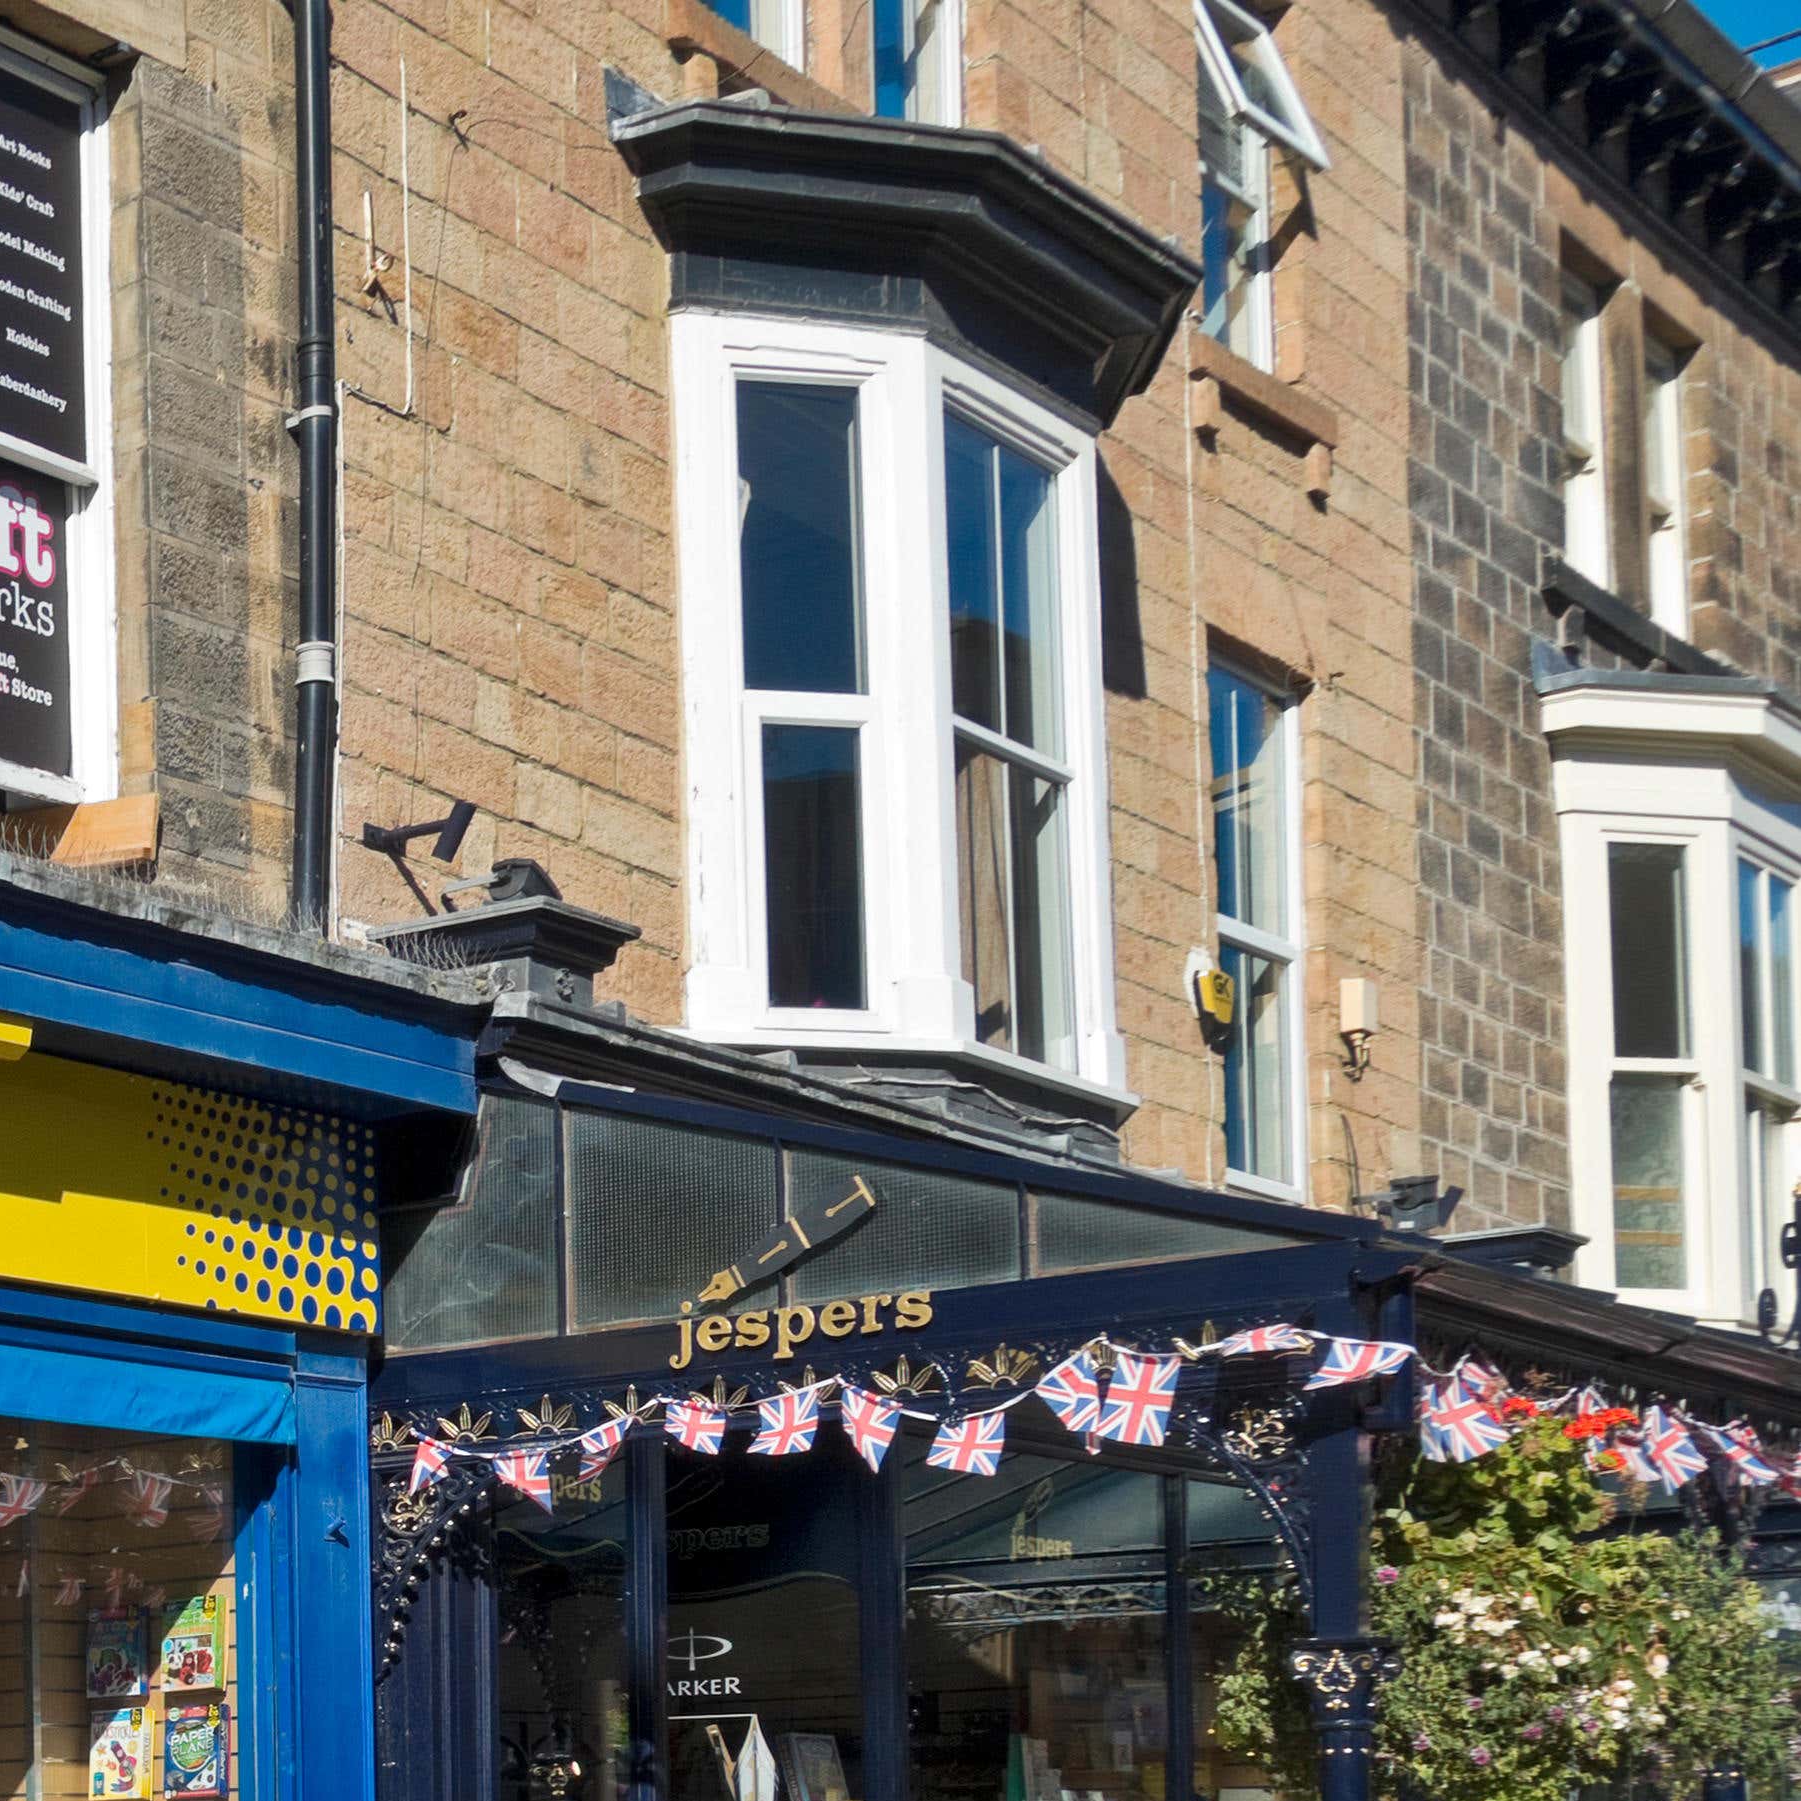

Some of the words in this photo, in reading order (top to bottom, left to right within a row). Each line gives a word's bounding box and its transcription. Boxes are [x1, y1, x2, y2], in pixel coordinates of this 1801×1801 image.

[18, 143, 52, 170] Books
[23, 239, 66, 272] Making
[27, 288, 71, 322] Crafting
[6, 327, 50, 357] Hobbies
[11, 675, 52, 707] Store
[668, 1289, 934, 1371] jespers
